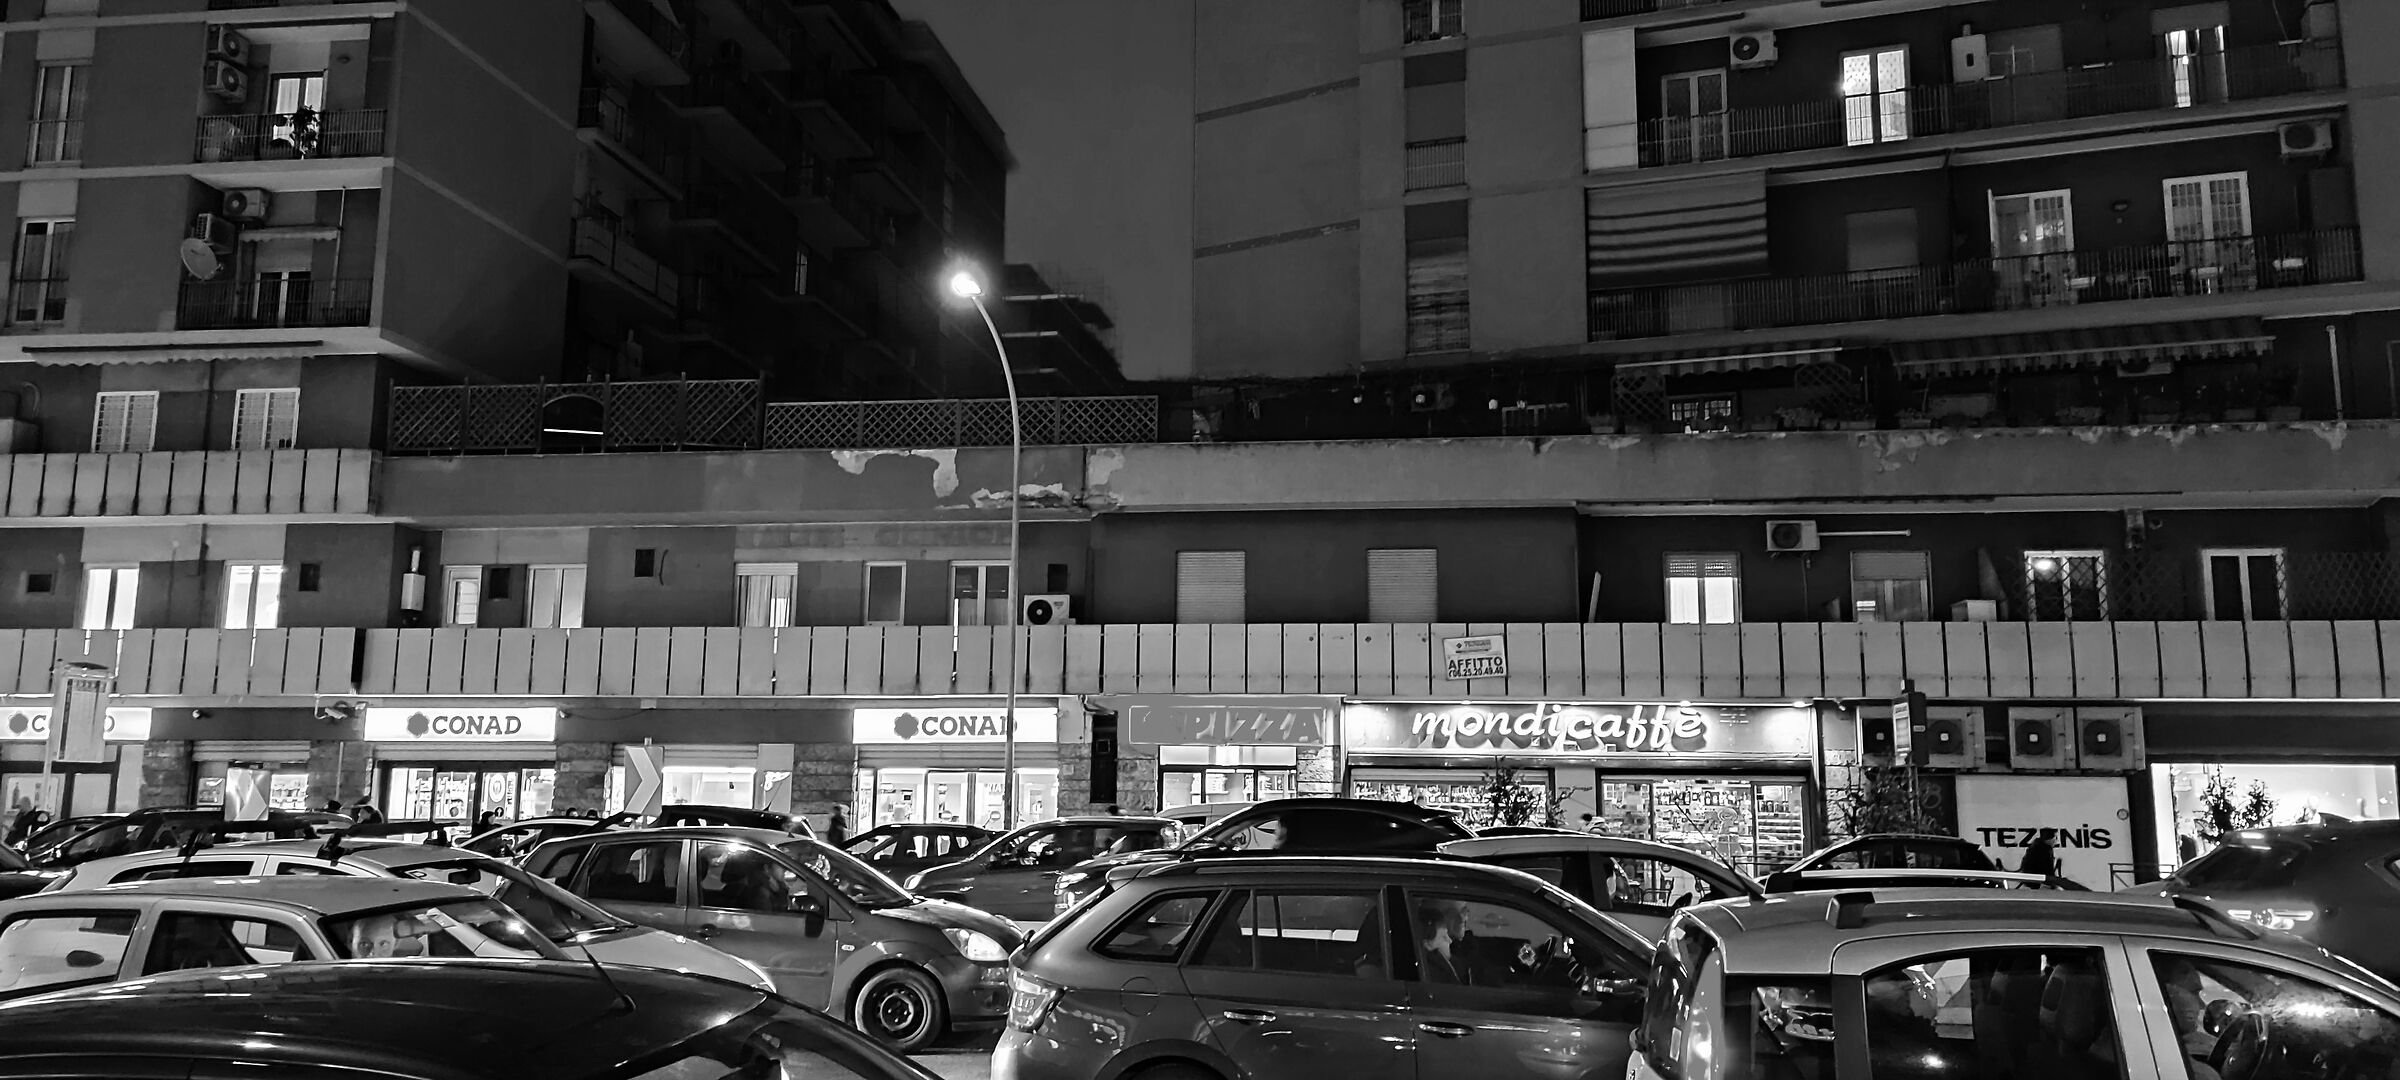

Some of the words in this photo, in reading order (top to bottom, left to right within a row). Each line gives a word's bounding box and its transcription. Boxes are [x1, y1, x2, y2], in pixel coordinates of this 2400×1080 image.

[1448, 656, 1503, 670] AFFITTO
[432, 715, 522, 735] CONAD
[1411, 703, 1702, 749] mondicaffè
